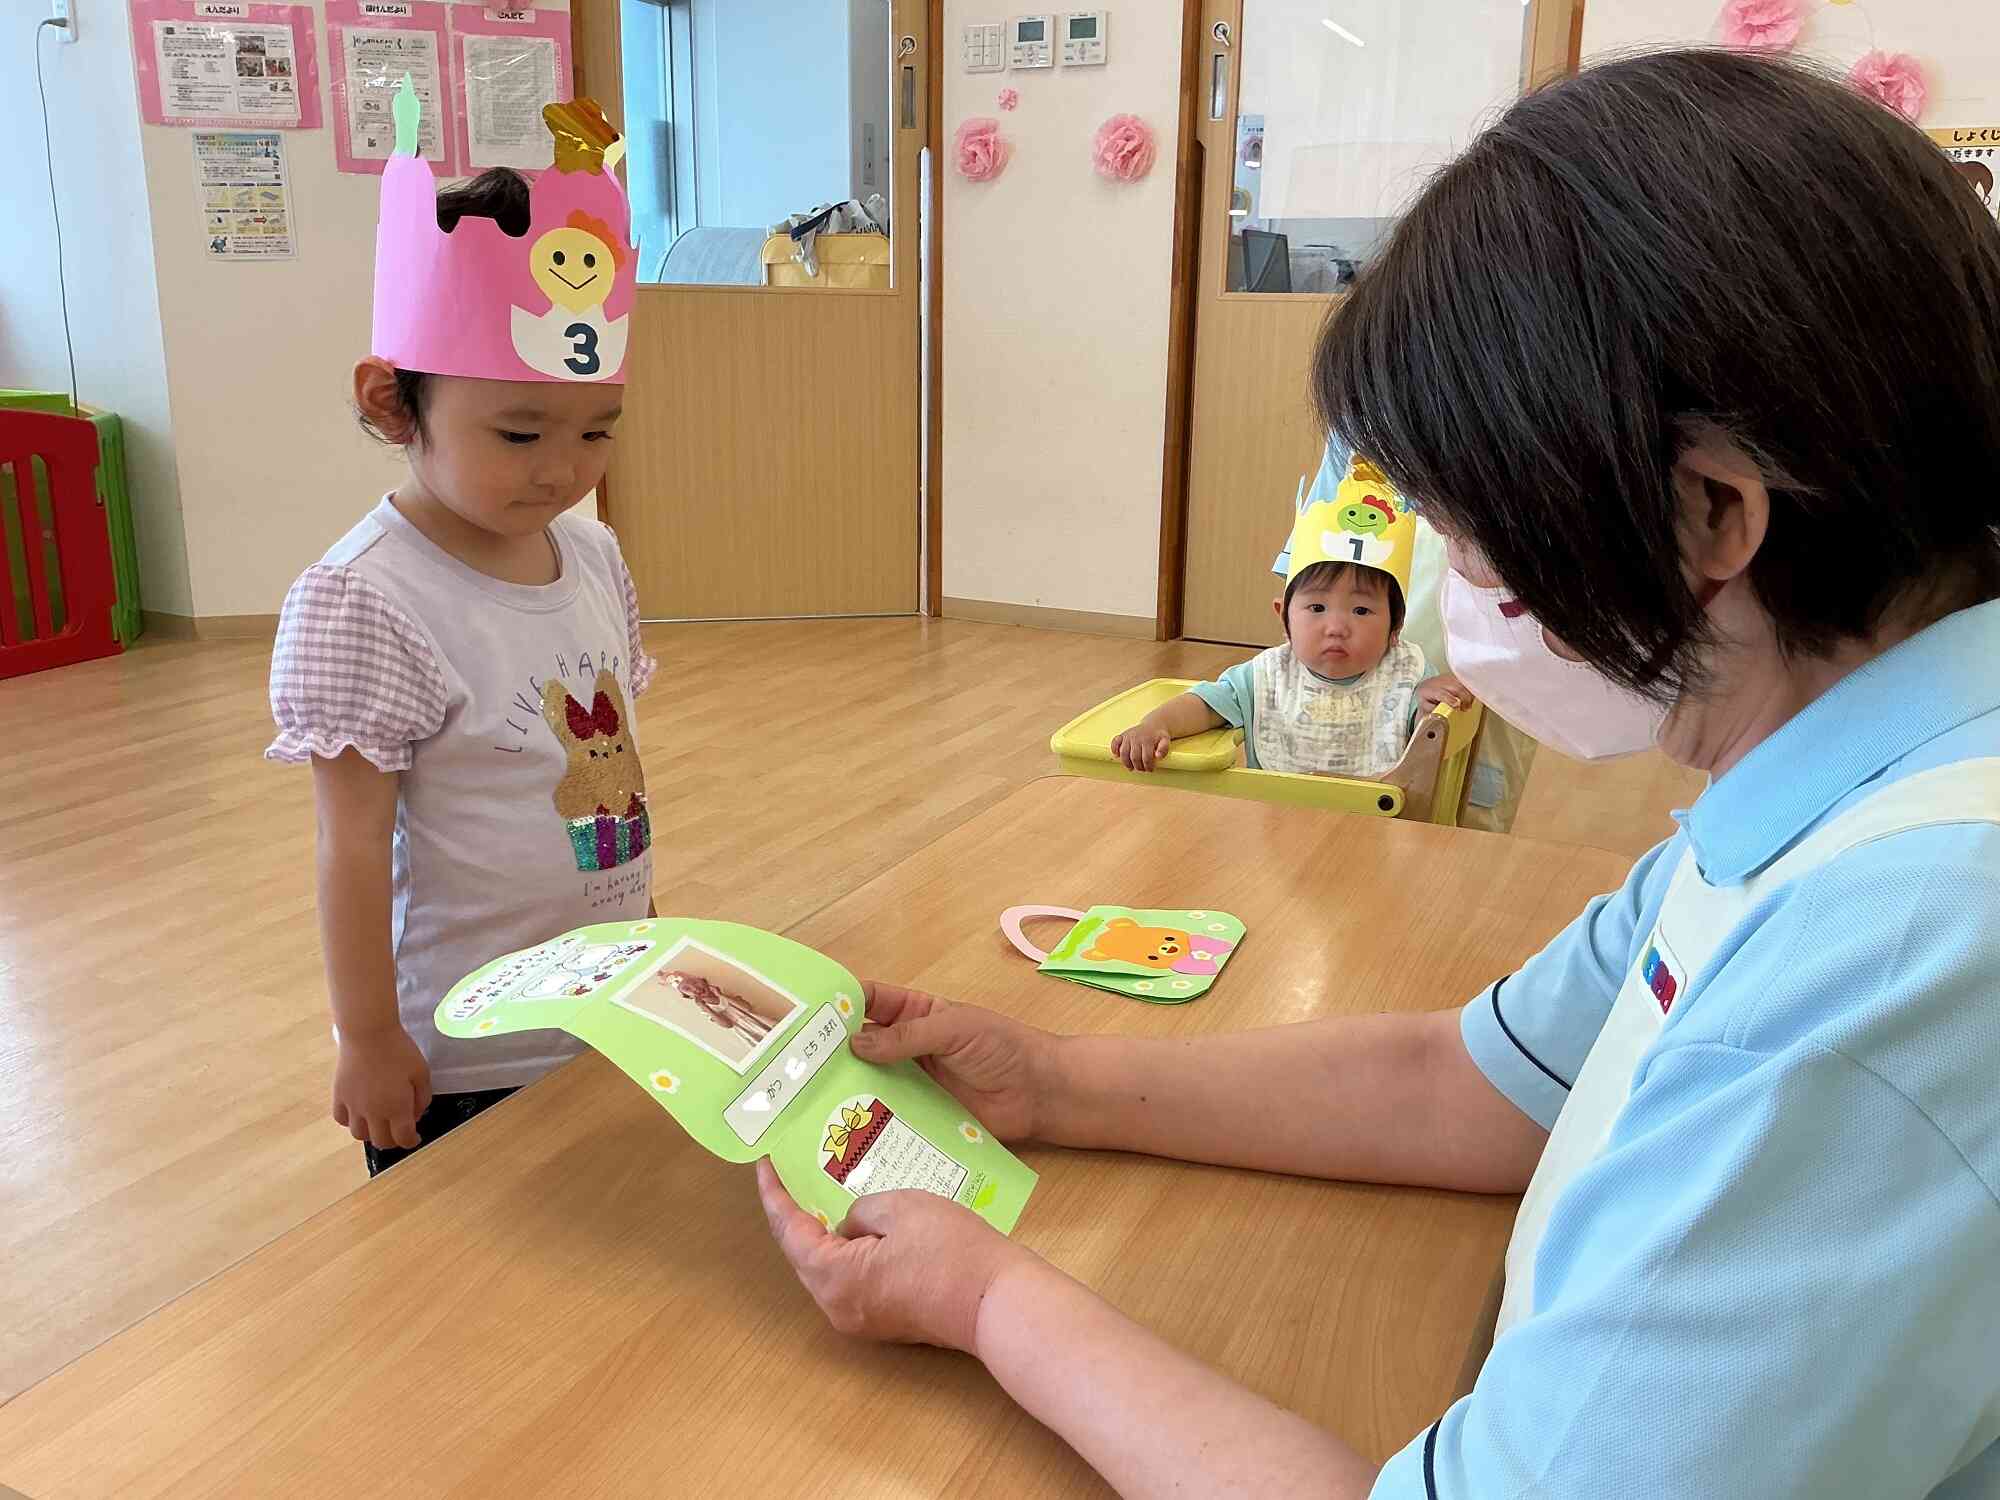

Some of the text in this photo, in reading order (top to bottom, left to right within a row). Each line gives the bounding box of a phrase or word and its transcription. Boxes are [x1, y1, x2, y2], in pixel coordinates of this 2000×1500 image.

[563, 322, 601, 375] 3
[1349, 538, 1364, 561] 1
[803, 1040, 819, 1059] にち
[818, 1018, 839, 1042] うまれ
